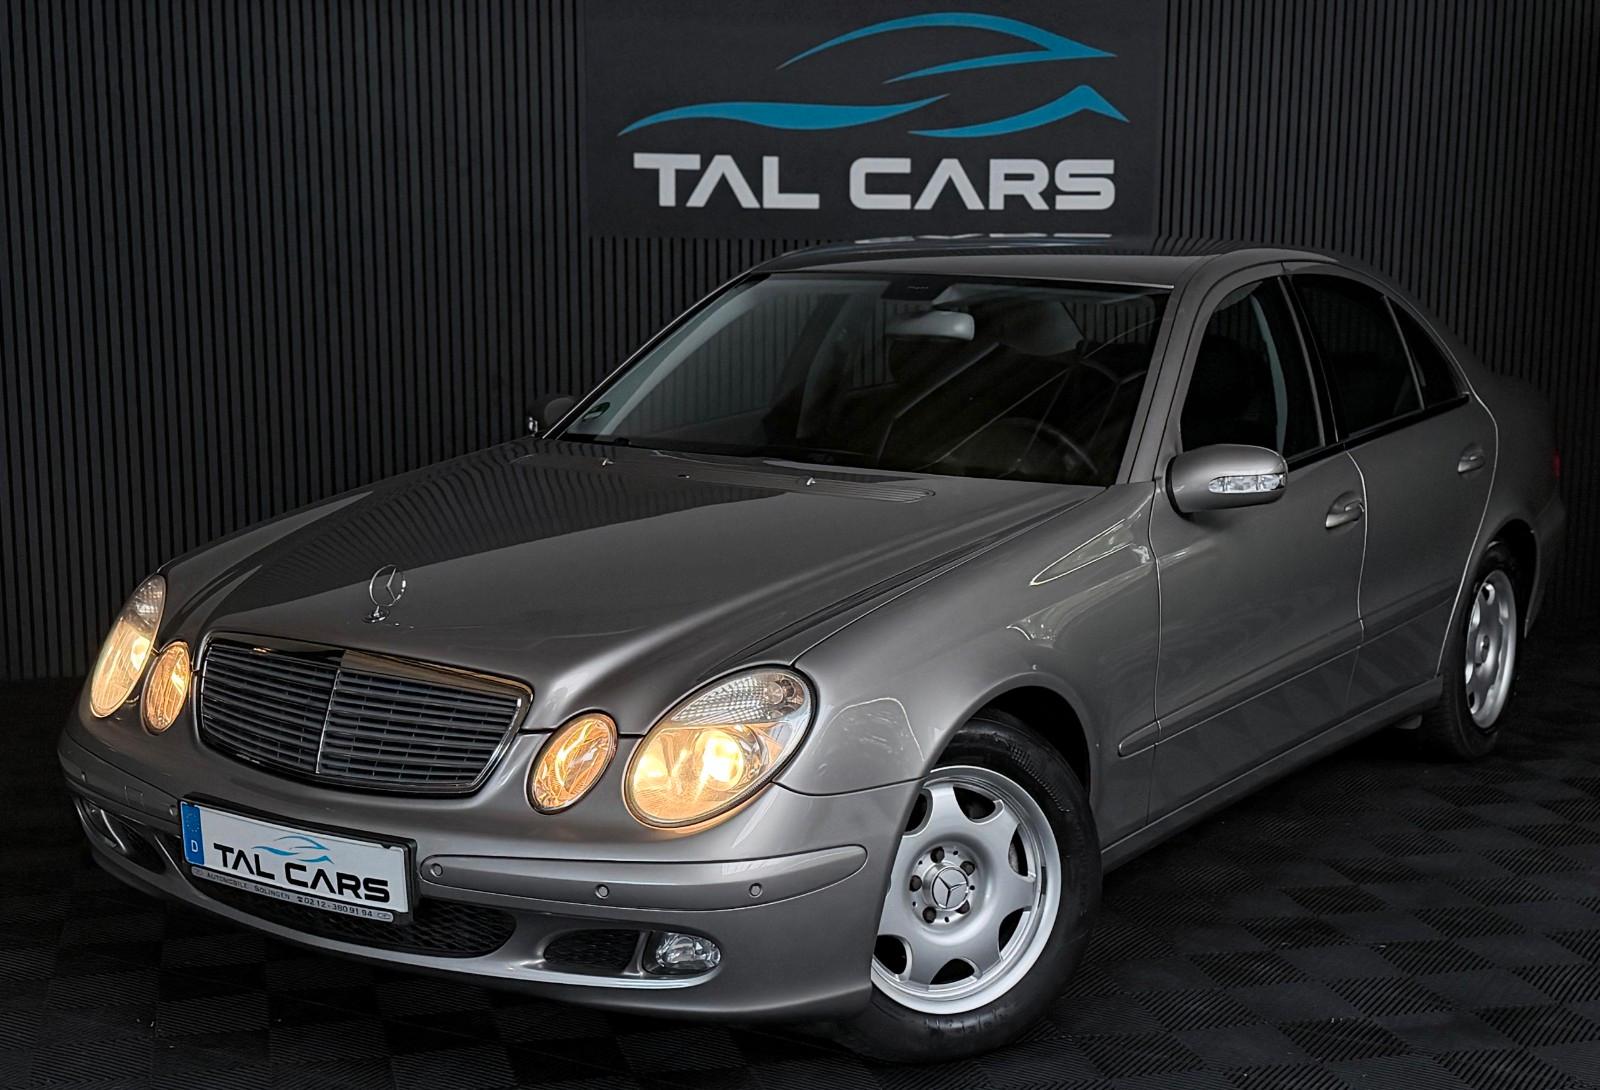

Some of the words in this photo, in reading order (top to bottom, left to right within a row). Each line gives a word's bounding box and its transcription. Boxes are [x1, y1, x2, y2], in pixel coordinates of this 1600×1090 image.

[633, 152, 820, 210] TAL
[849, 157, 1117, 211] CARS
[191, 840, 198, 853] D
[213, 842, 276, 881] TAL
[284, 862, 391, 903] CARS
[254, 885, 290, 900] SOLINGEN
